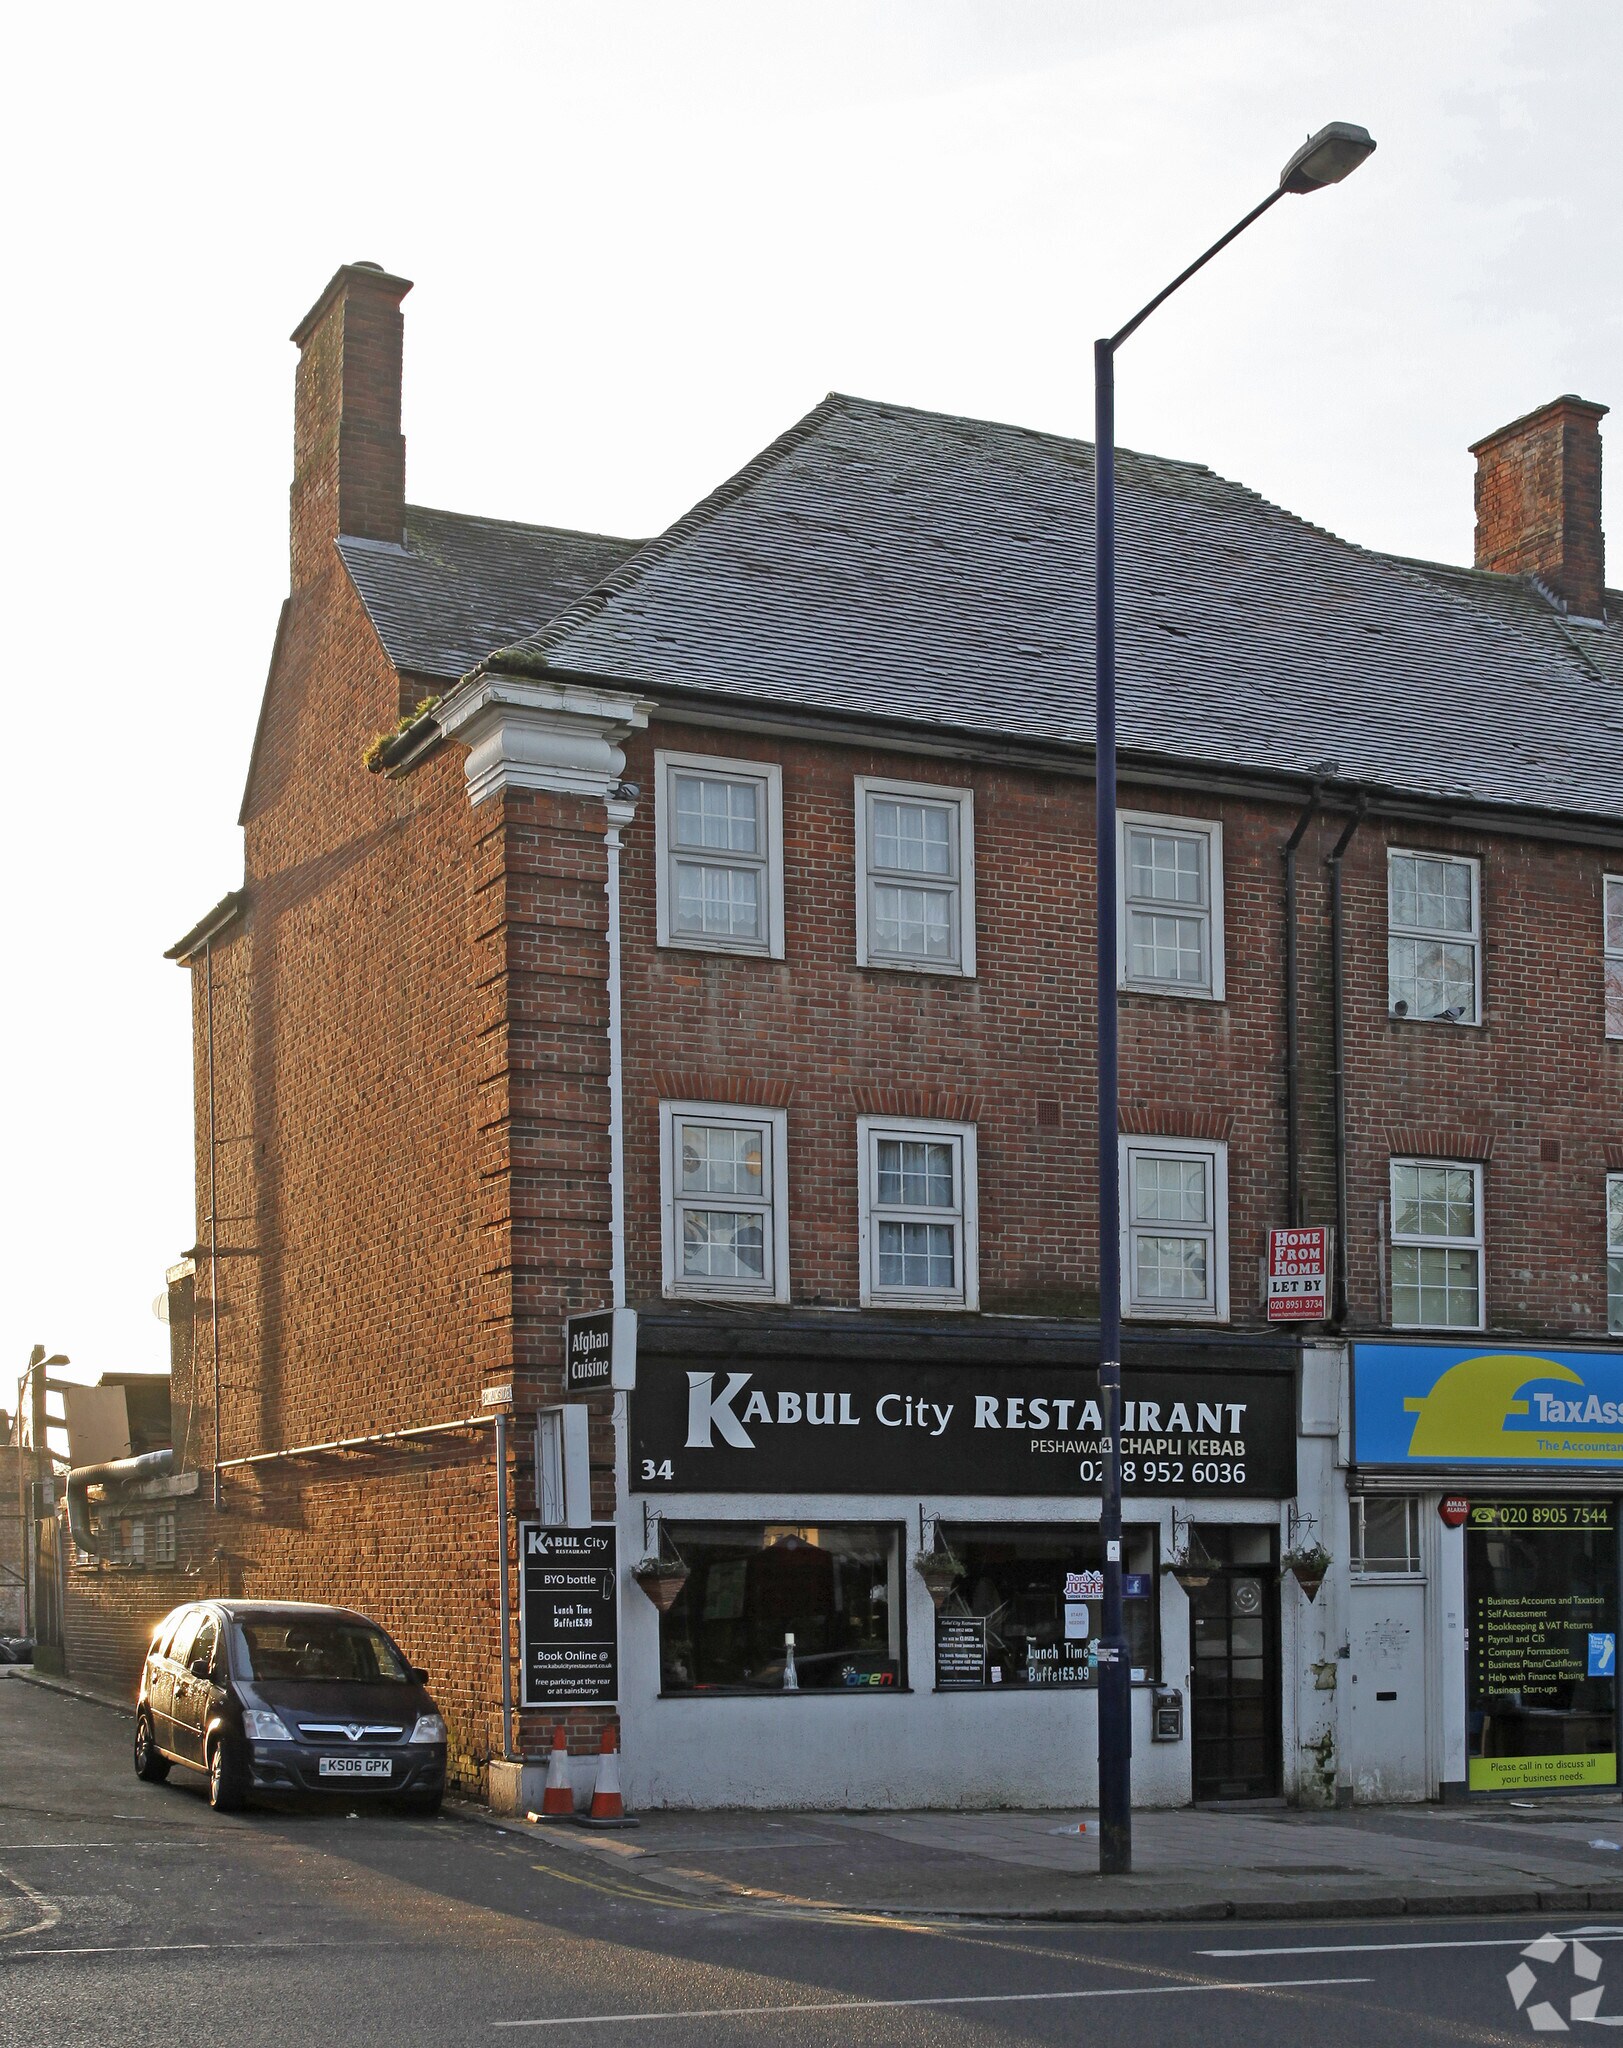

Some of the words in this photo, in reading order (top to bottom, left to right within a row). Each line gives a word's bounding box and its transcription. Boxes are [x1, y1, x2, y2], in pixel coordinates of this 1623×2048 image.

[1275, 1232, 1320, 1246] HOME
[1275, 1247, 1320, 1260] FROM
[1275, 1262, 1320, 1275] HOME
[1272, 1281, 1299, 1293] LET
[1304, 1280, 1321, 1291] BY
[1270, 1301, 1284, 1309] 020
[1286, 1300, 1303, 1309] 8951
[1305, 1300, 1322, 1308] 3734
[572, 1330, 609, 1355] Afghan
[572, 1358, 609, 1379] Cuisine
[684, 1371, 861, 1448] KABUL
[876, 1393, 954, 1436] City
[1103, 1438, 1112, 1451] 4
[1119, 1438, 1182, 1455] CHAPLI
[1188, 1439, 1246, 1456] KEBAB
[1537, 1440, 1559, 1450] The
[641, 1459, 675, 1480] 34
[1080, 1461, 1136, 1482] 028
[1143, 1462, 1185, 1483] 952
[1191, 1463, 1246, 1484] 6036
[1501, 1508, 1527, 1523] 020
[1532, 1508, 1567, 1522] 8905
[1573, 1508, 1608, 1522] 7544
[527, 1531, 580, 1554] KABUL
[584, 1537, 608, 1550] City
[544, 1574, 565, 1584] BYO
[567, 1574, 597, 1584] bottle
[1066, 1582, 1094, 1593] JUST
[1487, 1597, 1520, 1605] Business
[1521, 1597, 1556, 1605] Accounts
[1573, 1595, 1604, 1604] Taxation
[553, 1604, 574, 1614] Lunch
[576, 1604, 593, 1614] Time
[1487, 1609, 1502, 1618] Self
[1503, 1609, 1547, 1617] Assessment
[1487, 1622, 1537, 1632] Bookkeeping
[1539, 1622, 1545, 1630] &
[1545, 1621, 1562, 1629] VAT
[1563, 1621, 1593, 1629] Returns
[1488, 1635, 1513, 1645] Payroll
[1515, 1635, 1529, 1643] and
[1532, 1634, 1545, 1642] CIS
[537, 1651, 562, 1660] Book
[564, 1651, 597, 1660] Online
[599, 1651, 608, 1662] @
[1028, 1643, 1059, 1659] Lunch
[1064, 1642, 1088, 1659] Time
[1488, 1648, 1524, 1658] Company
[1527, 1647, 1569, 1655] Formations
[1488, 1660, 1520, 1669] Business
[1522, 1659, 1583, 1668] Plans/Cashflows
[550, 1678, 575, 1686] parking
[1488, 1673, 1506, 1683] Help
[1509, 1673, 1525, 1681] with
[1528, 1672, 1556, 1680] Finance
[1558, 1671, 1585, 1681] Raising
[564, 1687, 599, 1695] sainsburys
[1489, 1685, 1520, 1694] Business
[1522, 1685, 1557, 1695] Start-ups
[328, 1760, 362, 1771] KS06
[365, 1761, 389, 1771] GPK
[1491, 1762, 1516, 1771] Please
[1519, 1761, 1532, 1770] call
[1535, 1761, 1542, 1769] in
[1545, 1761, 1553, 1769] to
[1556, 1759, 1584, 1769] discuss
[1587, 1759, 1596, 1767] all
[1502, 1775, 1520, 1785] your
[1523, 1773, 1557, 1783] business
[1560, 1772, 1585, 1781] needs.
